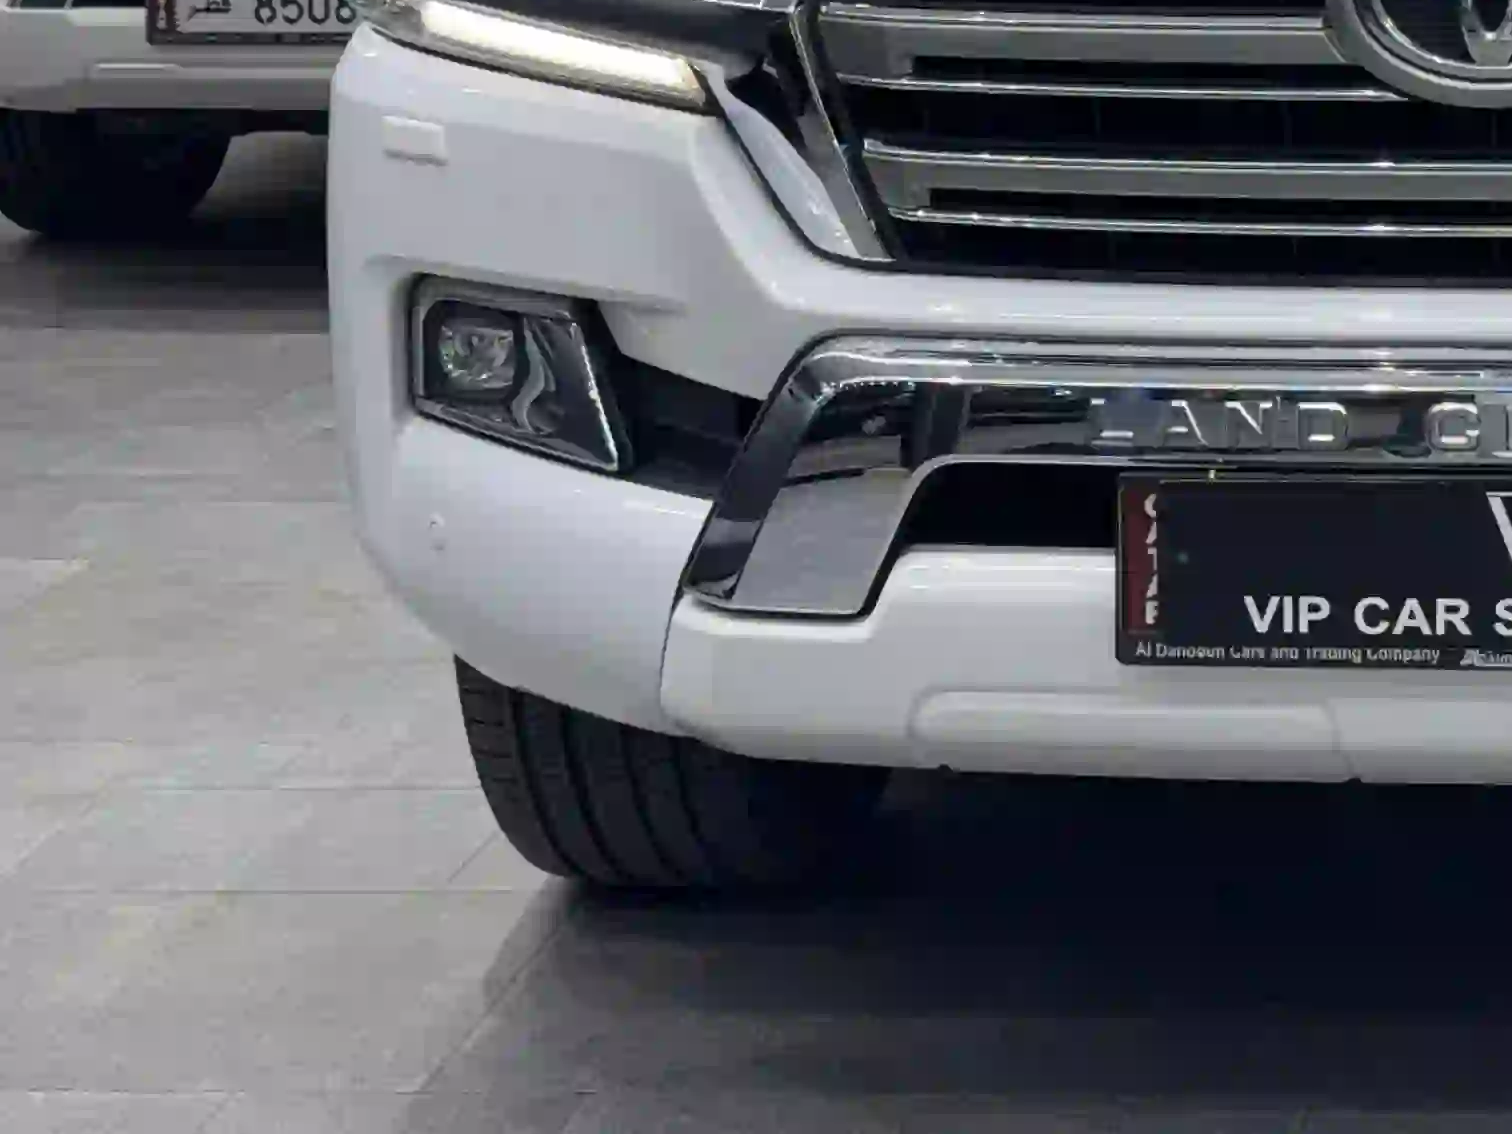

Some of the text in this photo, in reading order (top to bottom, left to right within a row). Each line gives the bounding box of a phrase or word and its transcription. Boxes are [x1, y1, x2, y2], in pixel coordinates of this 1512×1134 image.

[1088, 398, 1348, 450] LAND
[1243, 594, 1331, 634] VIP
[1353, 596, 1473, 636] CAR
[1270, 646, 1299, 660] and
[1365, 647, 1441, 665] Company
